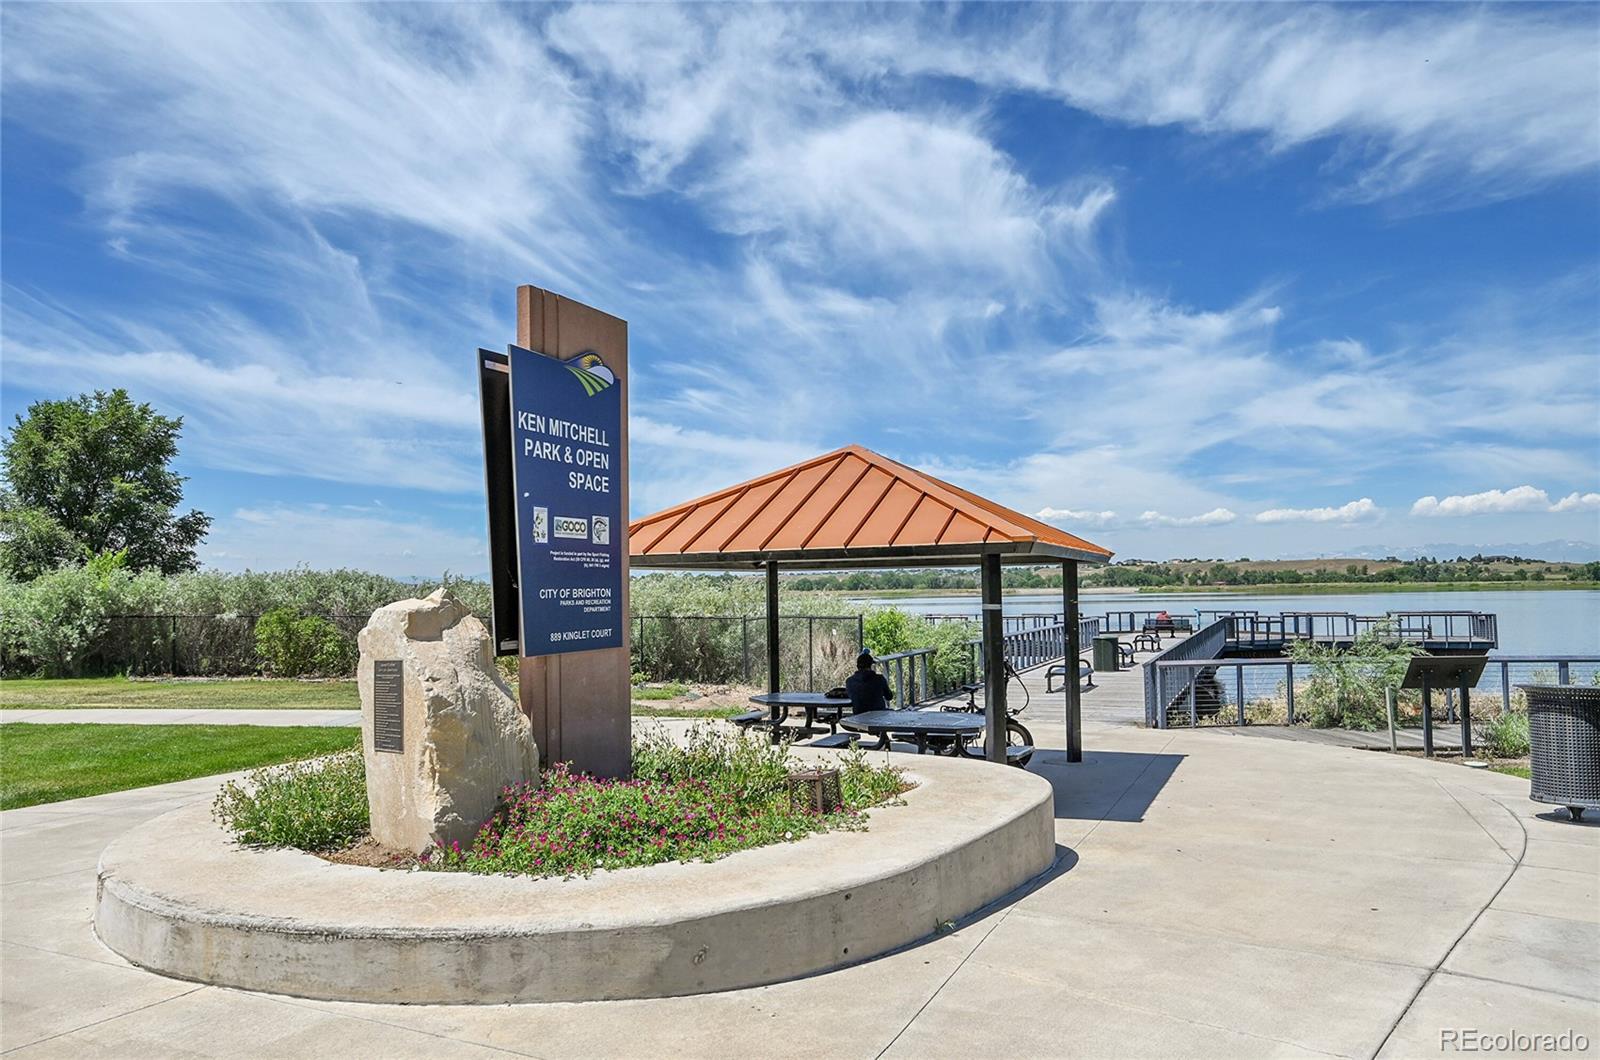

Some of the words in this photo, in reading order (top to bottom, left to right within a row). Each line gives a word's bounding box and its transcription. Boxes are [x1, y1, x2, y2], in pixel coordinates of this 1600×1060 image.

[518, 410, 545, 434] KEN
[548, 418, 609, 447] MITCHELL
[524, 438, 561, 462] PARK
[564, 446, 573, 464] &
[576, 449, 609, 470] OPEN
[568, 471, 609, 493] SPACE
[562, 520, 586, 533] GOCO
[539, 588, 558, 599] CITY
[560, 588, 571, 599] OF
[572, 588, 611, 598] BRIGHTON
[550, 632, 561, 642] 889
[562, 630, 590, 641] KINGLET
[591, 628, 612, 639] COURT
